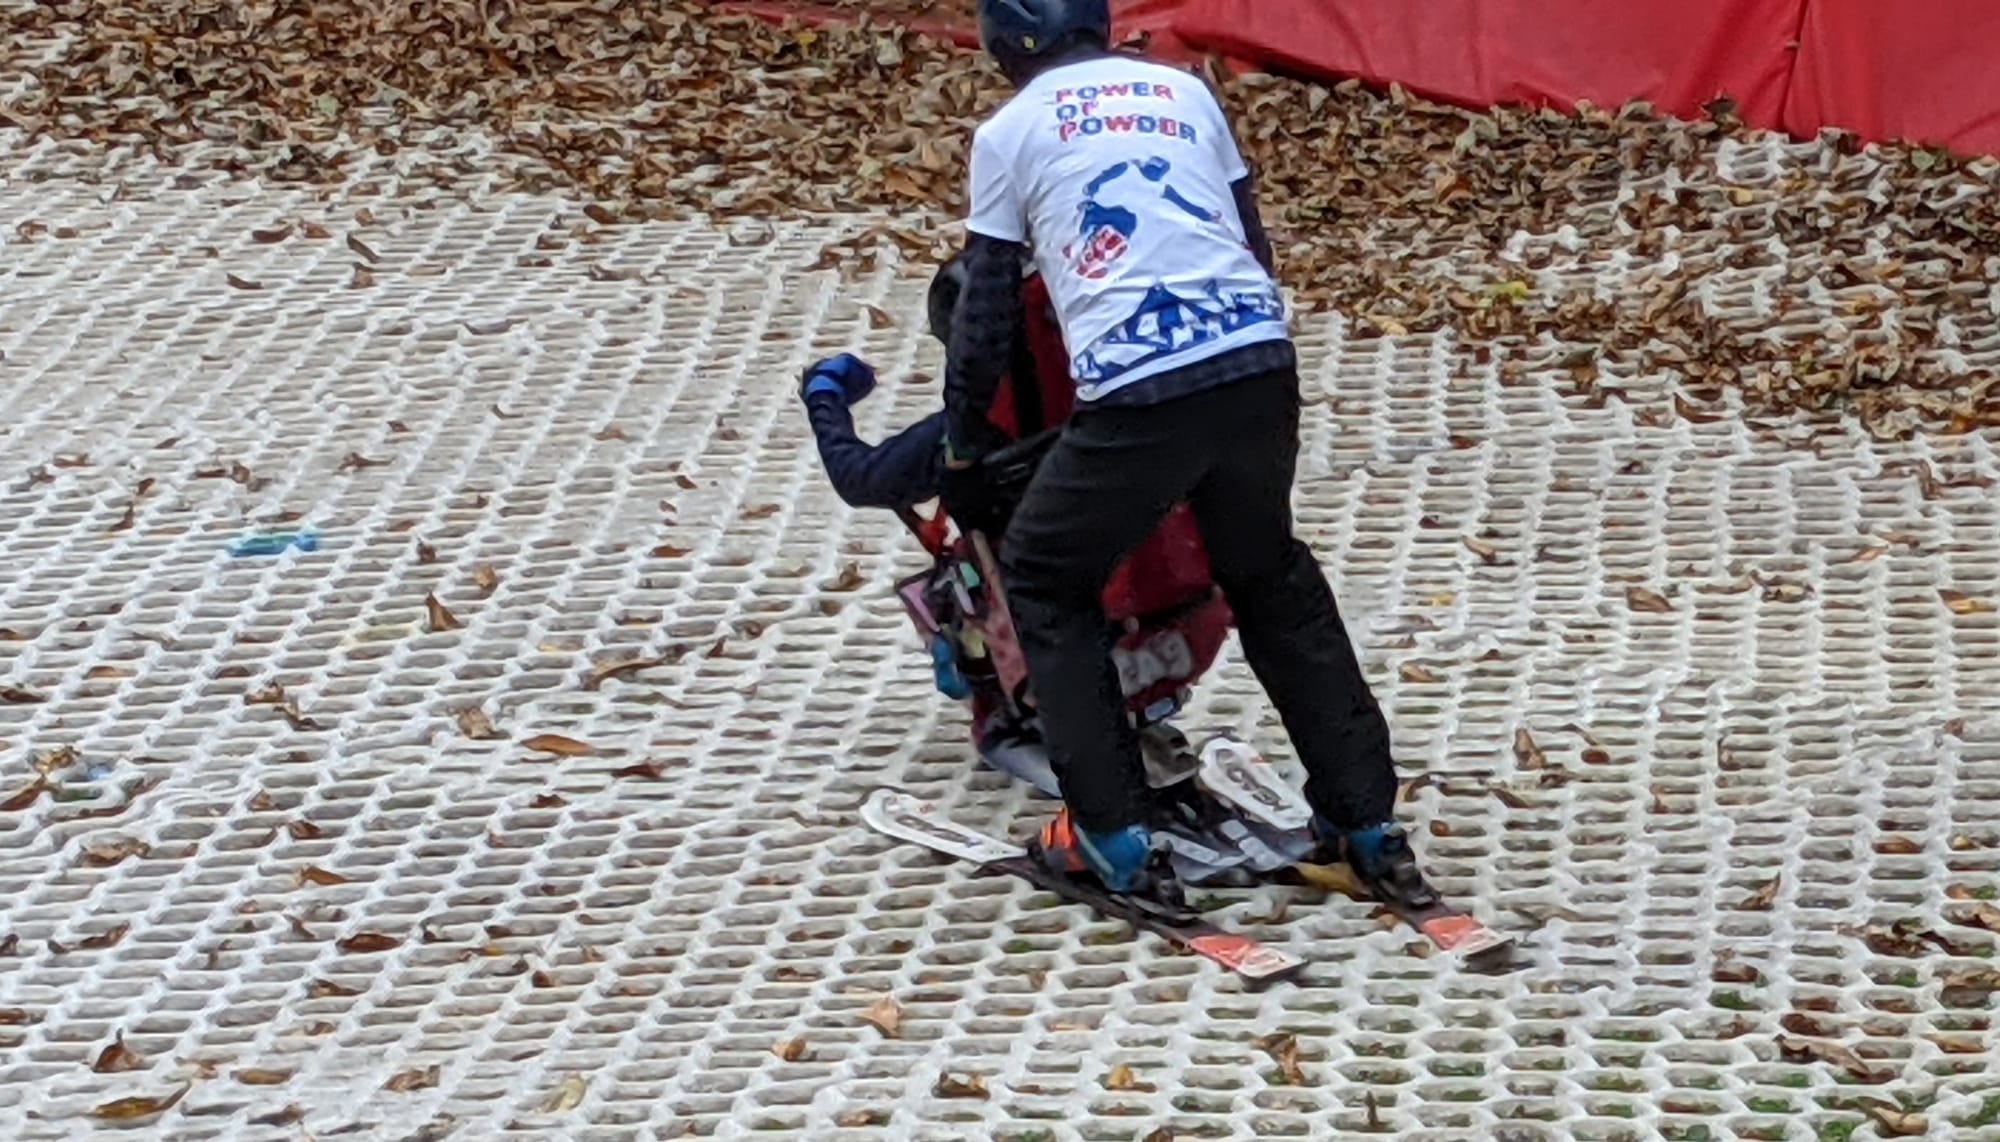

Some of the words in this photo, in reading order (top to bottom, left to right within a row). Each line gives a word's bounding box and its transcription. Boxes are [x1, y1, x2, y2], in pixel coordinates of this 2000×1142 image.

[1056, 82, 1175, 103] POWER
[1056, 101, 1099, 121] OF
[1059, 115, 1197, 144] POWDER
